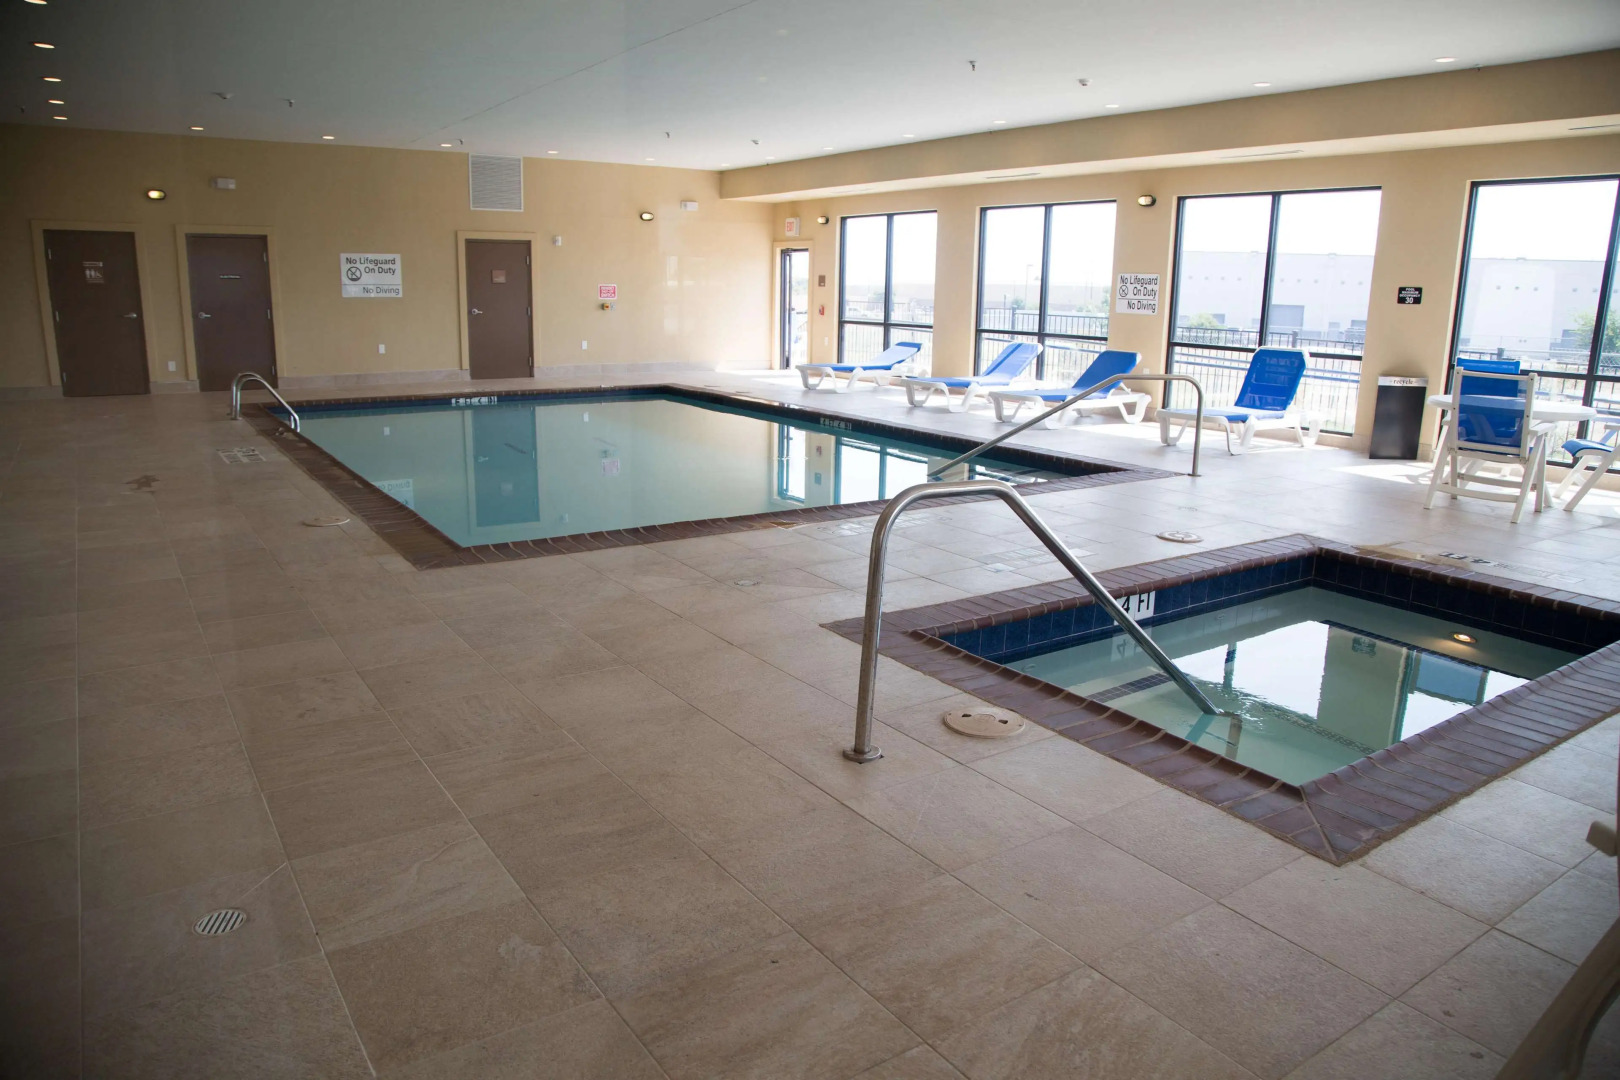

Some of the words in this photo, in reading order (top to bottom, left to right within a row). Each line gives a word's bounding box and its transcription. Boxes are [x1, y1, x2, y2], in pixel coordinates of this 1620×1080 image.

[345, 257, 357, 265] No
[360, 256, 396, 267] Lifeguard
[364, 266, 376, 274] On
[378, 266, 396, 275] Duty
[1120, 275, 1129, 285] No
[1130, 275, 1158, 287] Lifeguard
[376, 287, 400, 296] Diving
[1132, 286, 1142, 296] On
[1143, 286, 1157, 299] Duty
[1127, 300, 1136, 310] No
[1137, 300, 1156, 313] Diving
[1393, 378, 1414, 386] recycle
[1121, 595, 1130, 614] 4
